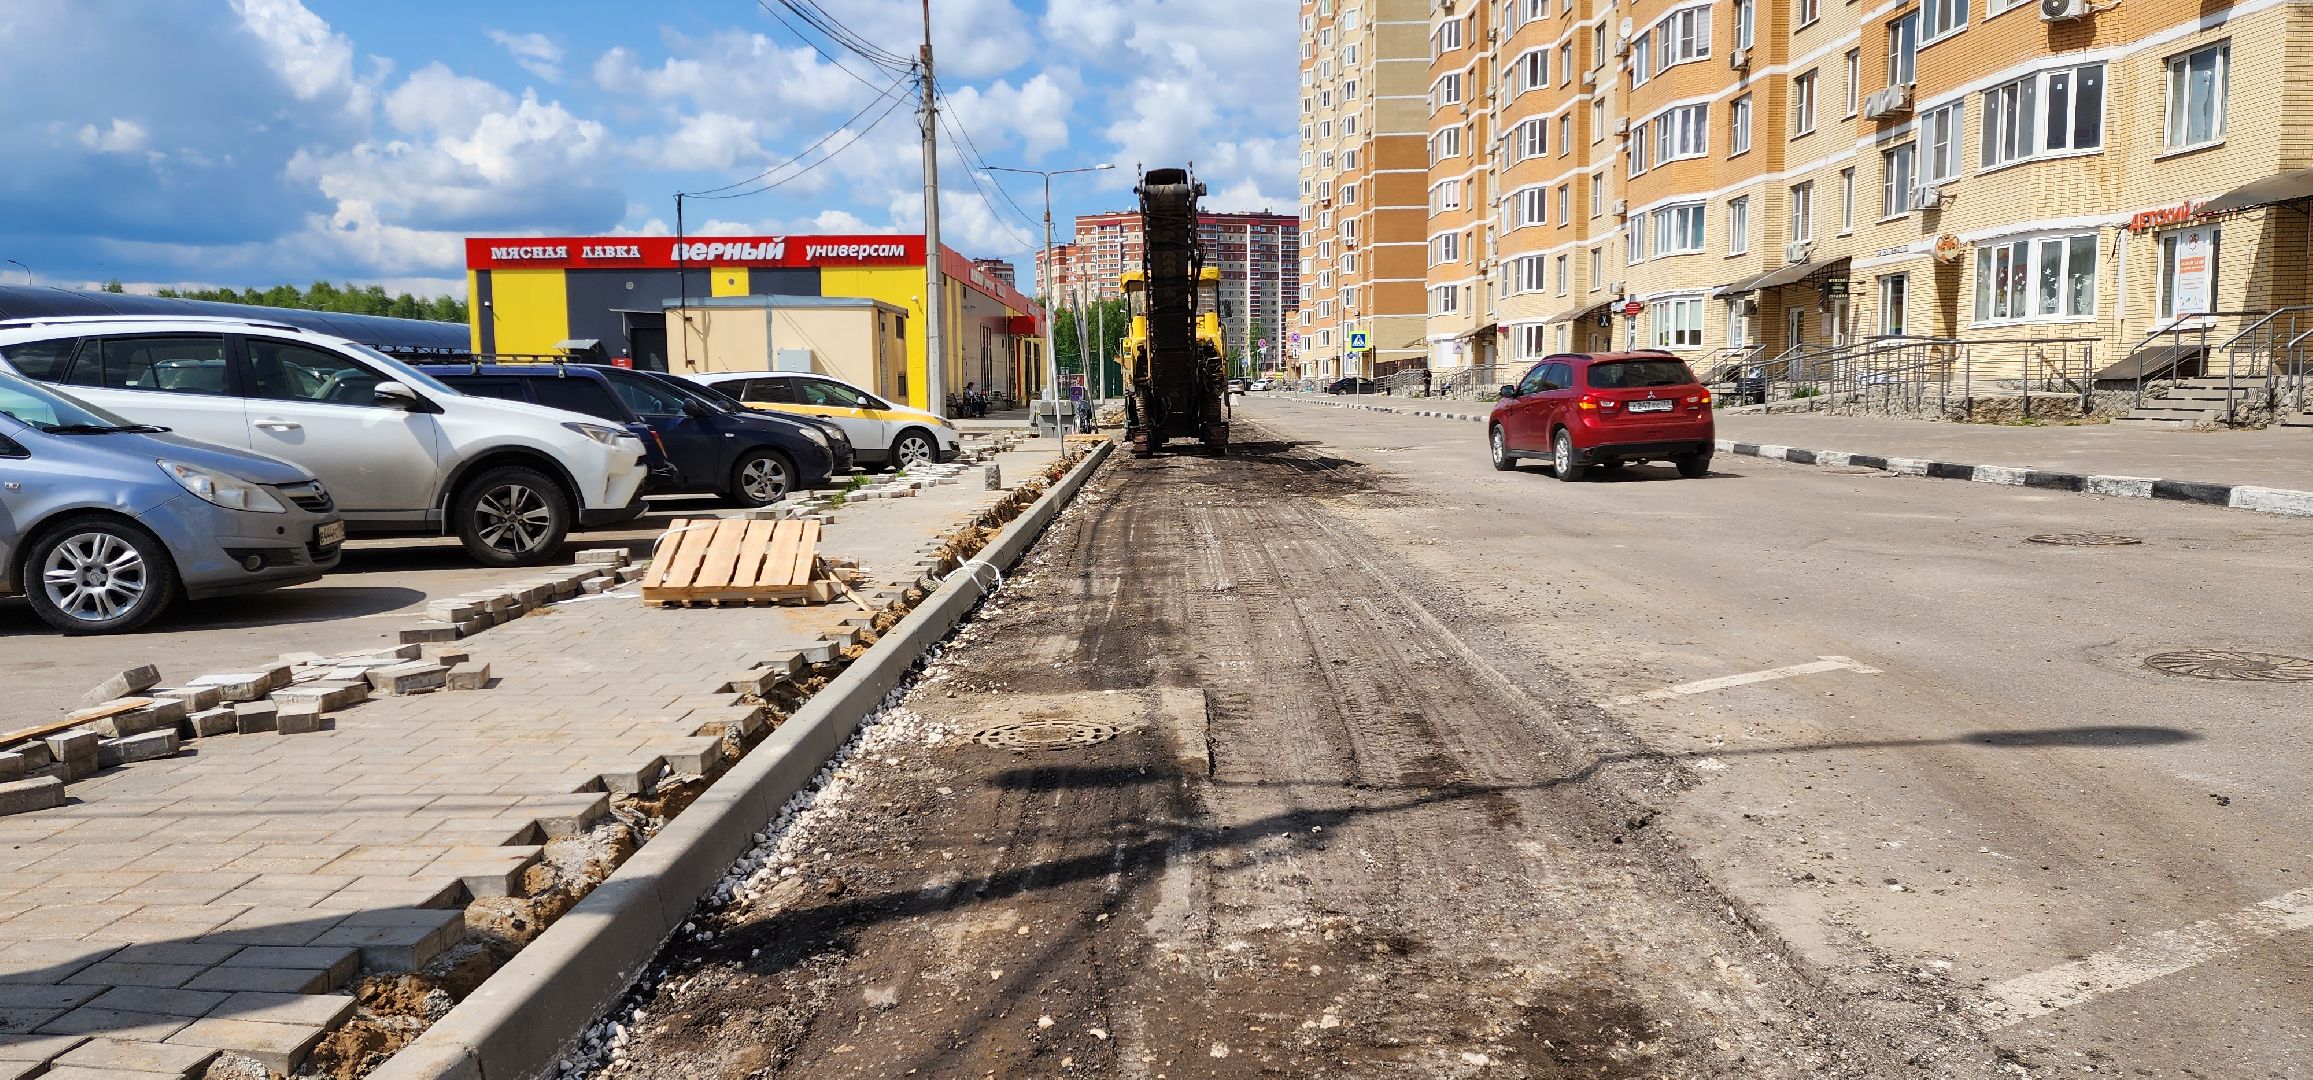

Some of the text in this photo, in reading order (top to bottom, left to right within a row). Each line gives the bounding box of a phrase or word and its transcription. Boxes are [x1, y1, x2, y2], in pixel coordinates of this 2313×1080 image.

[2128, 200, 2190, 233] ДЕТСКИЙ
[491, 245, 641, 260] МЯСНАЯ ЛАВКА
[805, 243, 905, 261] универсам
